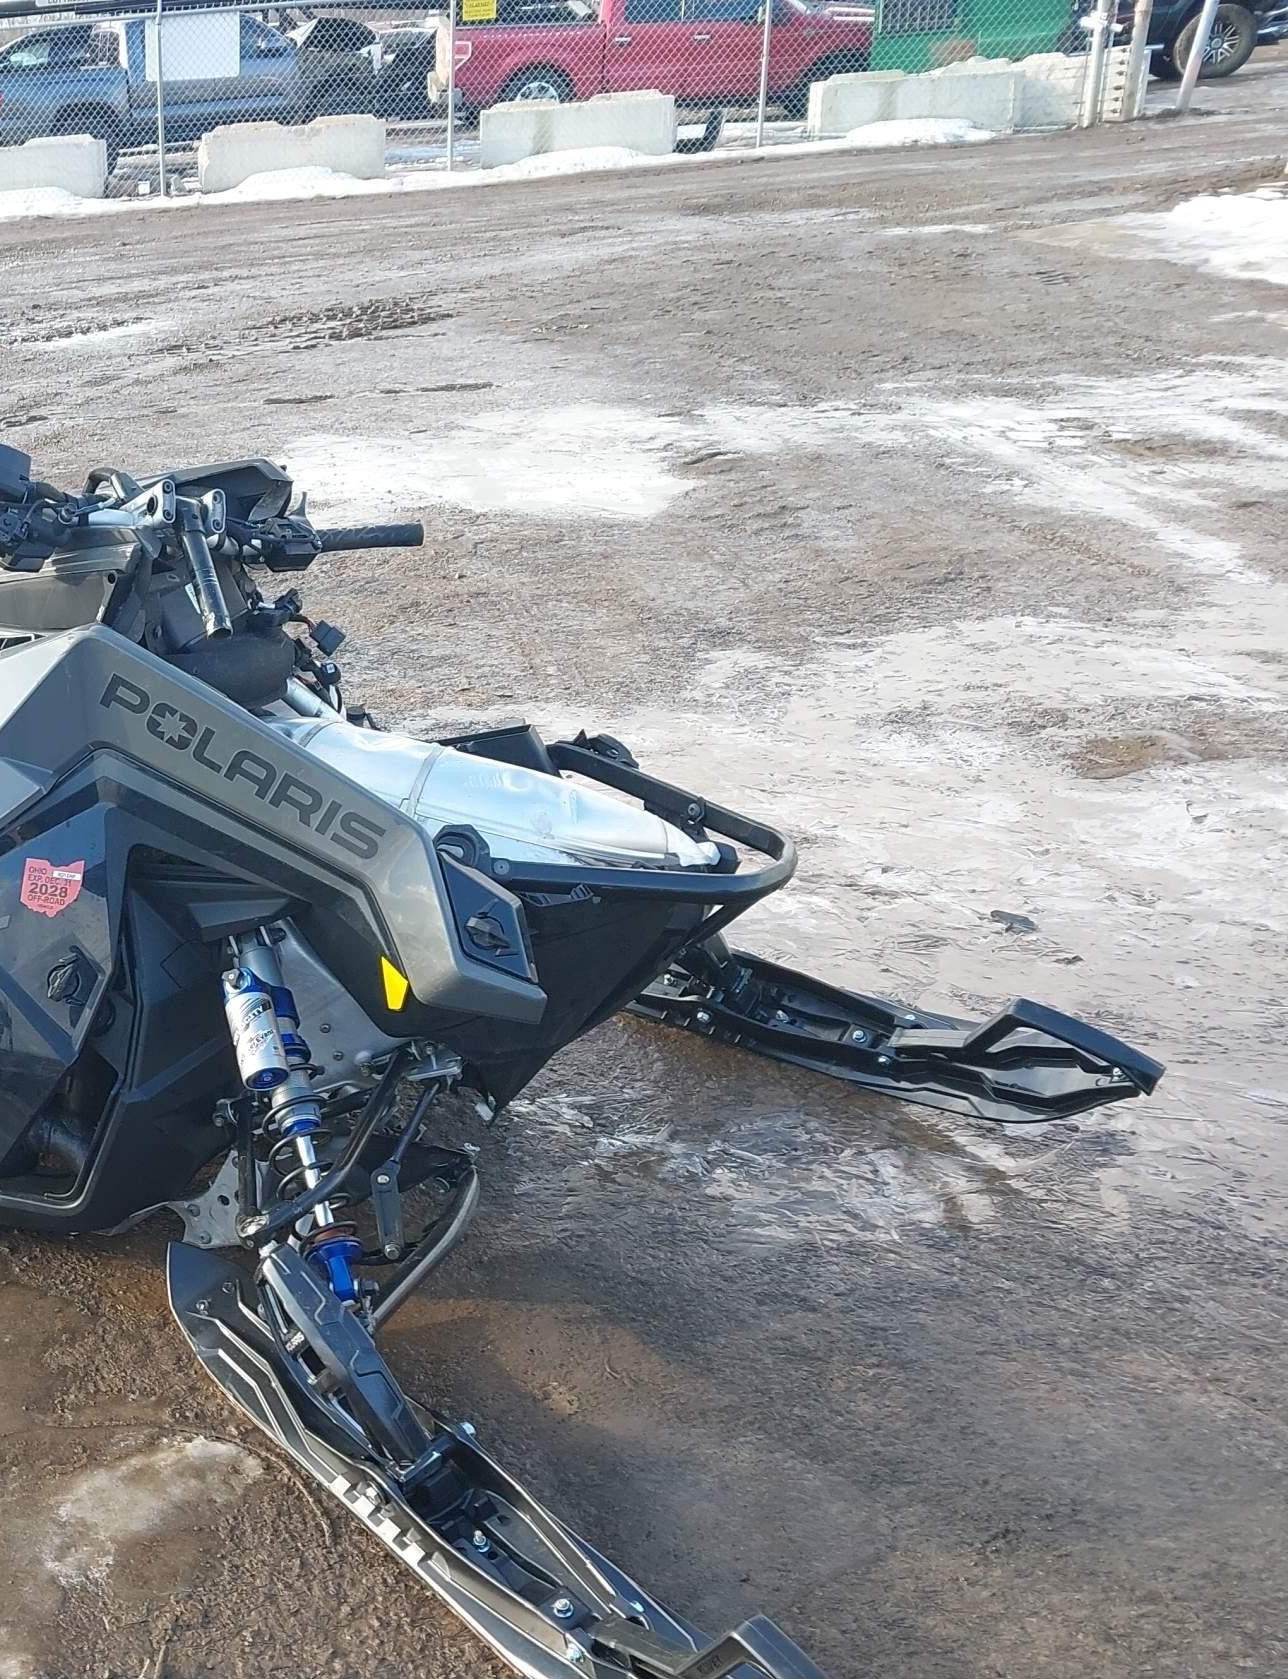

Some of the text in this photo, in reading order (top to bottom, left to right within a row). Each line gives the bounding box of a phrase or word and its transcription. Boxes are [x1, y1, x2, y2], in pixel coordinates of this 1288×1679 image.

[99, 673, 387, 860] POLARIS
[28, 866, 48, 875] OHIO
[45, 876, 60, 885] DEC
[28, 882, 68, 898] 2028
[27, 894, 65, 905] OFF-ROAD
